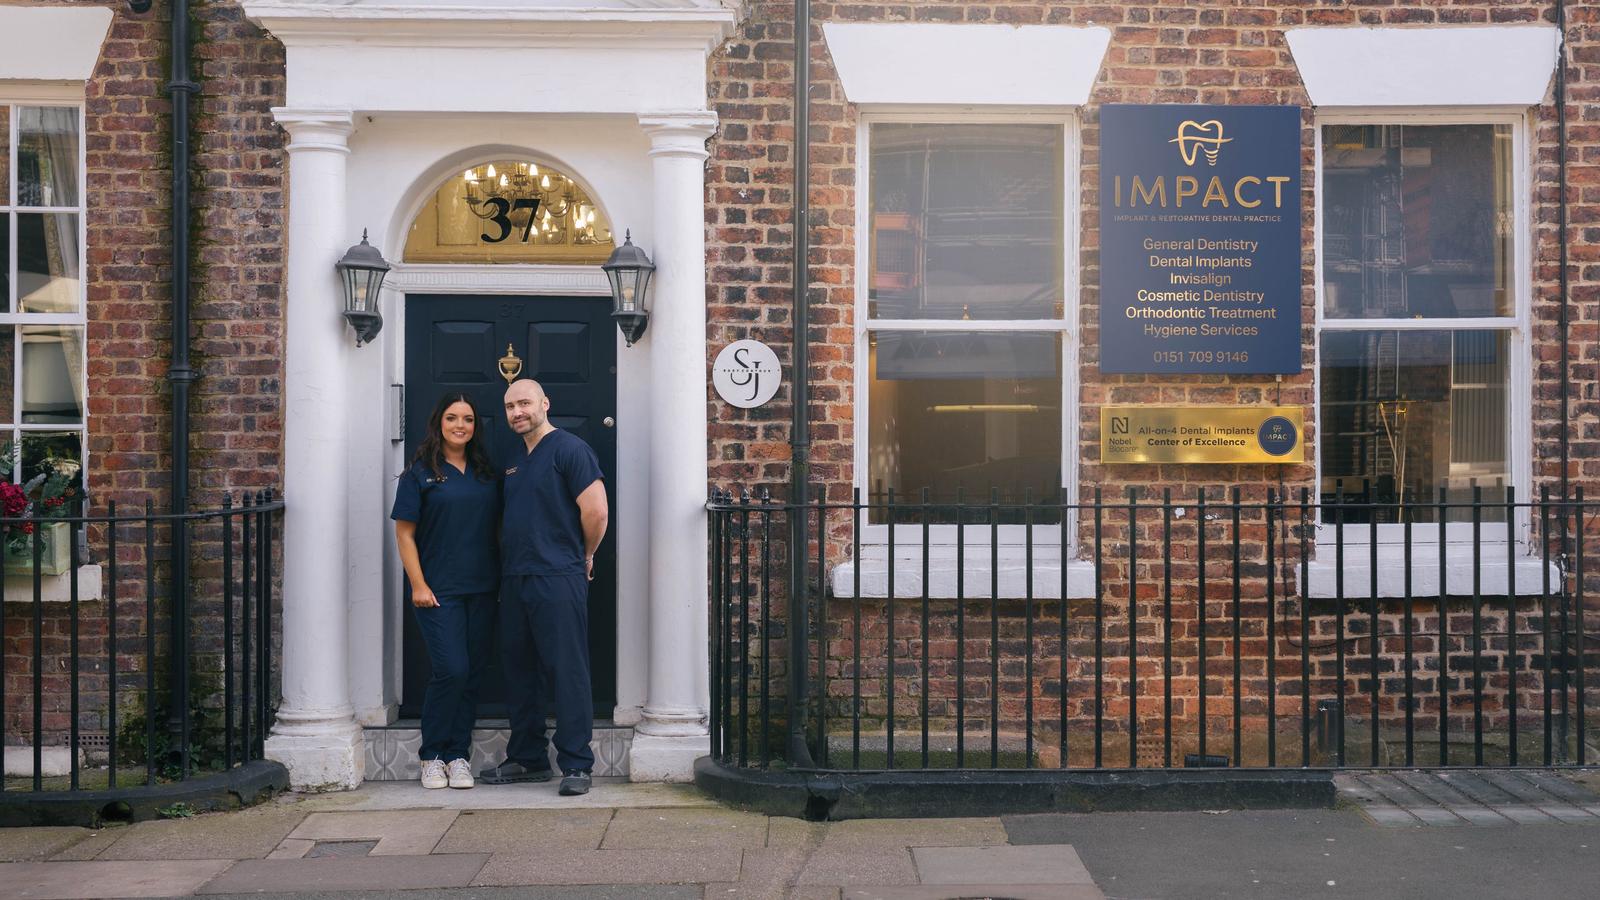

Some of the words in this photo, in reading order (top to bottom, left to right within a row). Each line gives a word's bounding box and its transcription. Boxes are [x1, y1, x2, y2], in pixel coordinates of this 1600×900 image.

[1114, 175, 1290, 208] IMPACT
[480, 196, 541, 243] 37
[1114, 214, 1150, 223] IMPLANT
[1159, 214, 1210, 223] RESTORATIVE
[1212, 214, 1242, 223] DENTAL
[1243, 214, 1281, 223] PRACTICE
[1143, 238, 1194, 250] General
[1198, 238, 1258, 253] Dentistry
[1150, 255, 1193, 267] Dental
[1196, 255, 1252, 270] Implants
[1170, 272, 1231, 287] Invisalign
[1137, 289, 1200, 302] Cosmetic
[1203, 289, 1264, 304] Dentistry
[1125, 306, 1206, 319] Orthodontic
[1209, 306, 1276, 319] Treatment
[1144, 323, 1197, 338] Hygiene
[1200, 323, 1258, 336] Services
[1153, 351, 1184, 363] 0151
[1188, 351, 1213, 363] 709
[1216, 351, 1249, 363] 9146
[1138, 427, 1177, 435] All-on-4
[1180, 426, 1211, 435] Dental
[1214, 427, 1255, 437] Implants
[1109, 438, 1132, 446] Nobel
[1147, 438, 1179, 447] Center
[1182, 438, 1193, 447] of
[1195, 438, 1246, 447] Excellence
